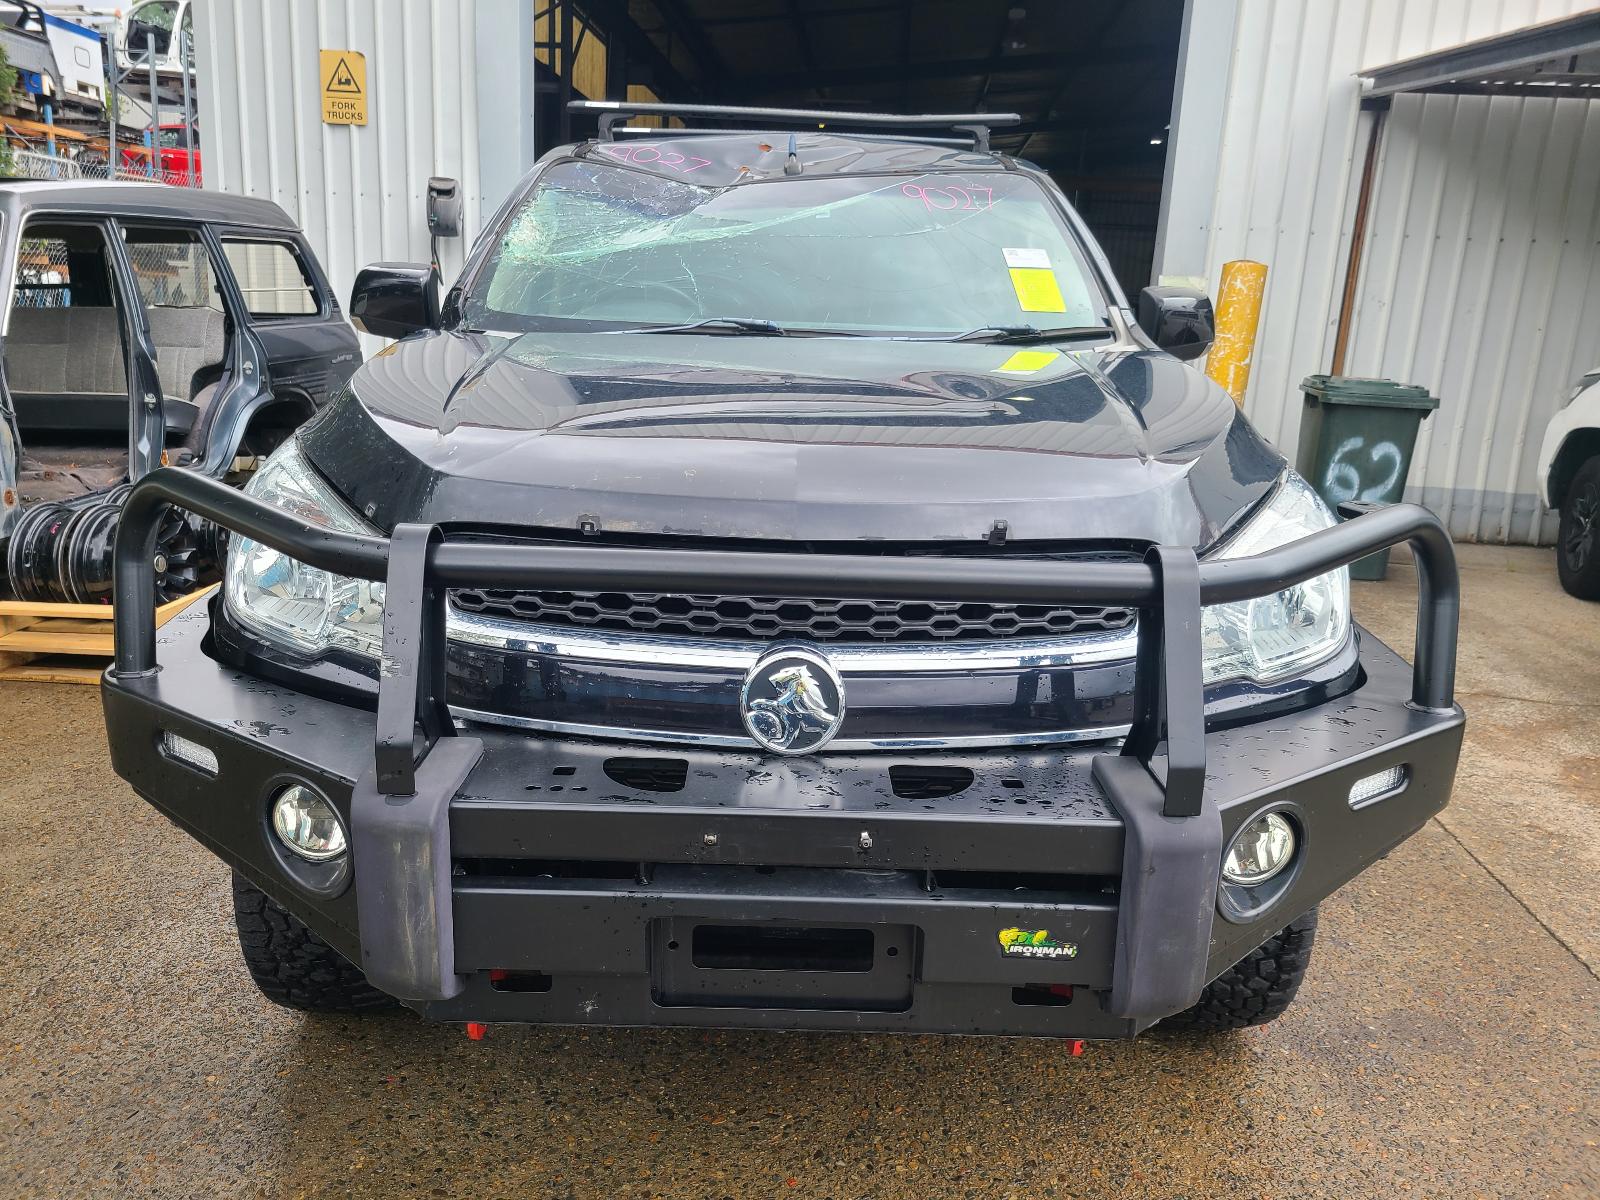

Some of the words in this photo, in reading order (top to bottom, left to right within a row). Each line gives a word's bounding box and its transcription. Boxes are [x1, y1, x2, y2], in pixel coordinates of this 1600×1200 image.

[326, 110, 364, 121] TRUCKS
[331, 101, 357, 111] FORK
[607, 144, 713, 174] 9027
[902, 183, 993, 216] 9027
[1325, 436, 1402, 503] 62
[1009, 945, 1074, 956] IRONMAN
